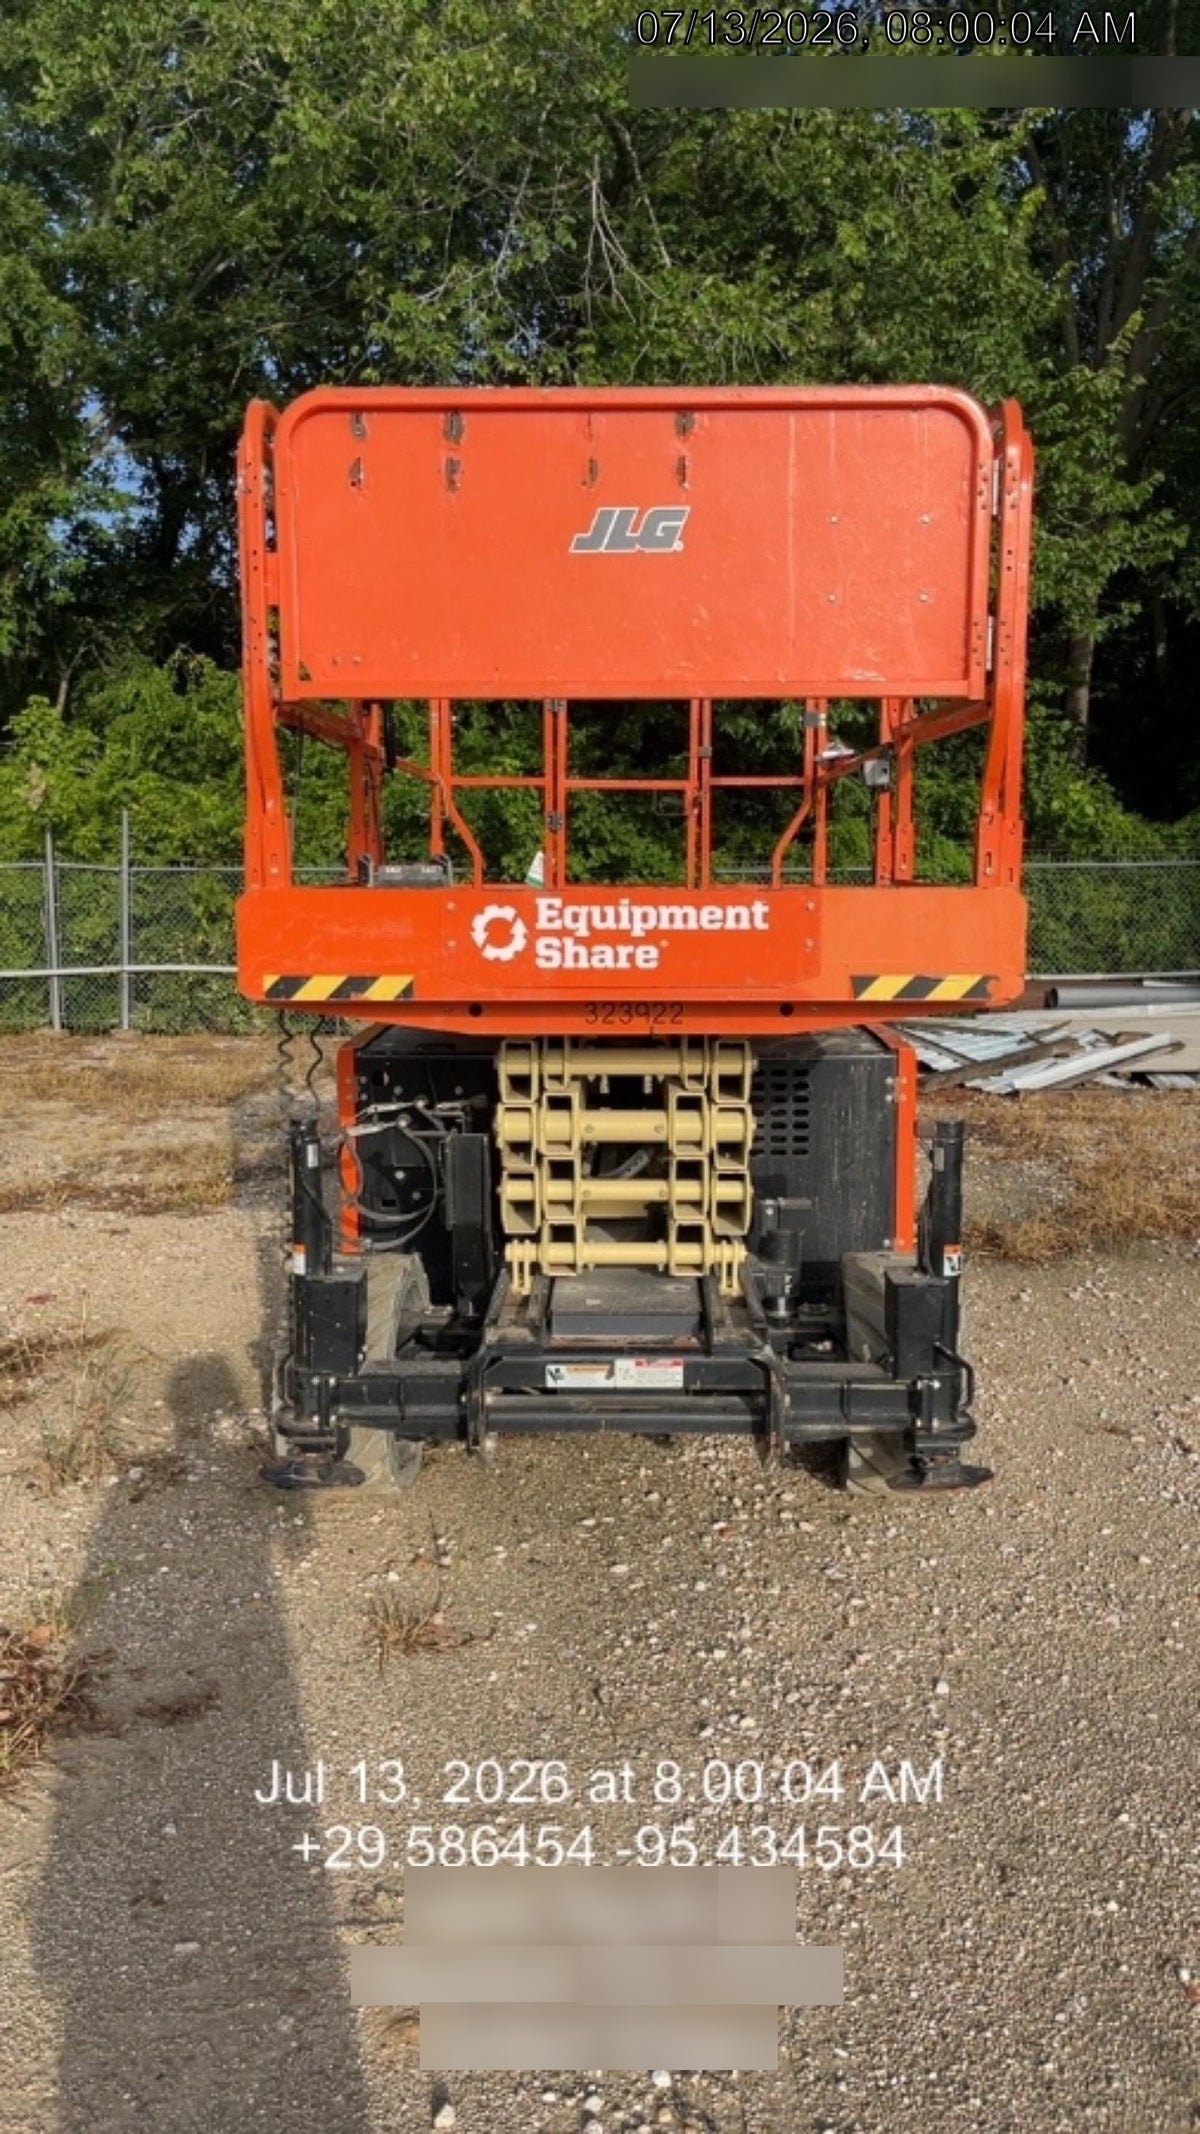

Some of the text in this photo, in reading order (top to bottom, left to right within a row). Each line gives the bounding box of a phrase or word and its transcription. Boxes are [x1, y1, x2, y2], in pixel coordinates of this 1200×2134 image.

[569, 506, 691, 553] JLG
[536, 897, 769, 937] Equipment
[535, 936, 660, 969] Share
[584, 1001, 684, 1025] 323922
